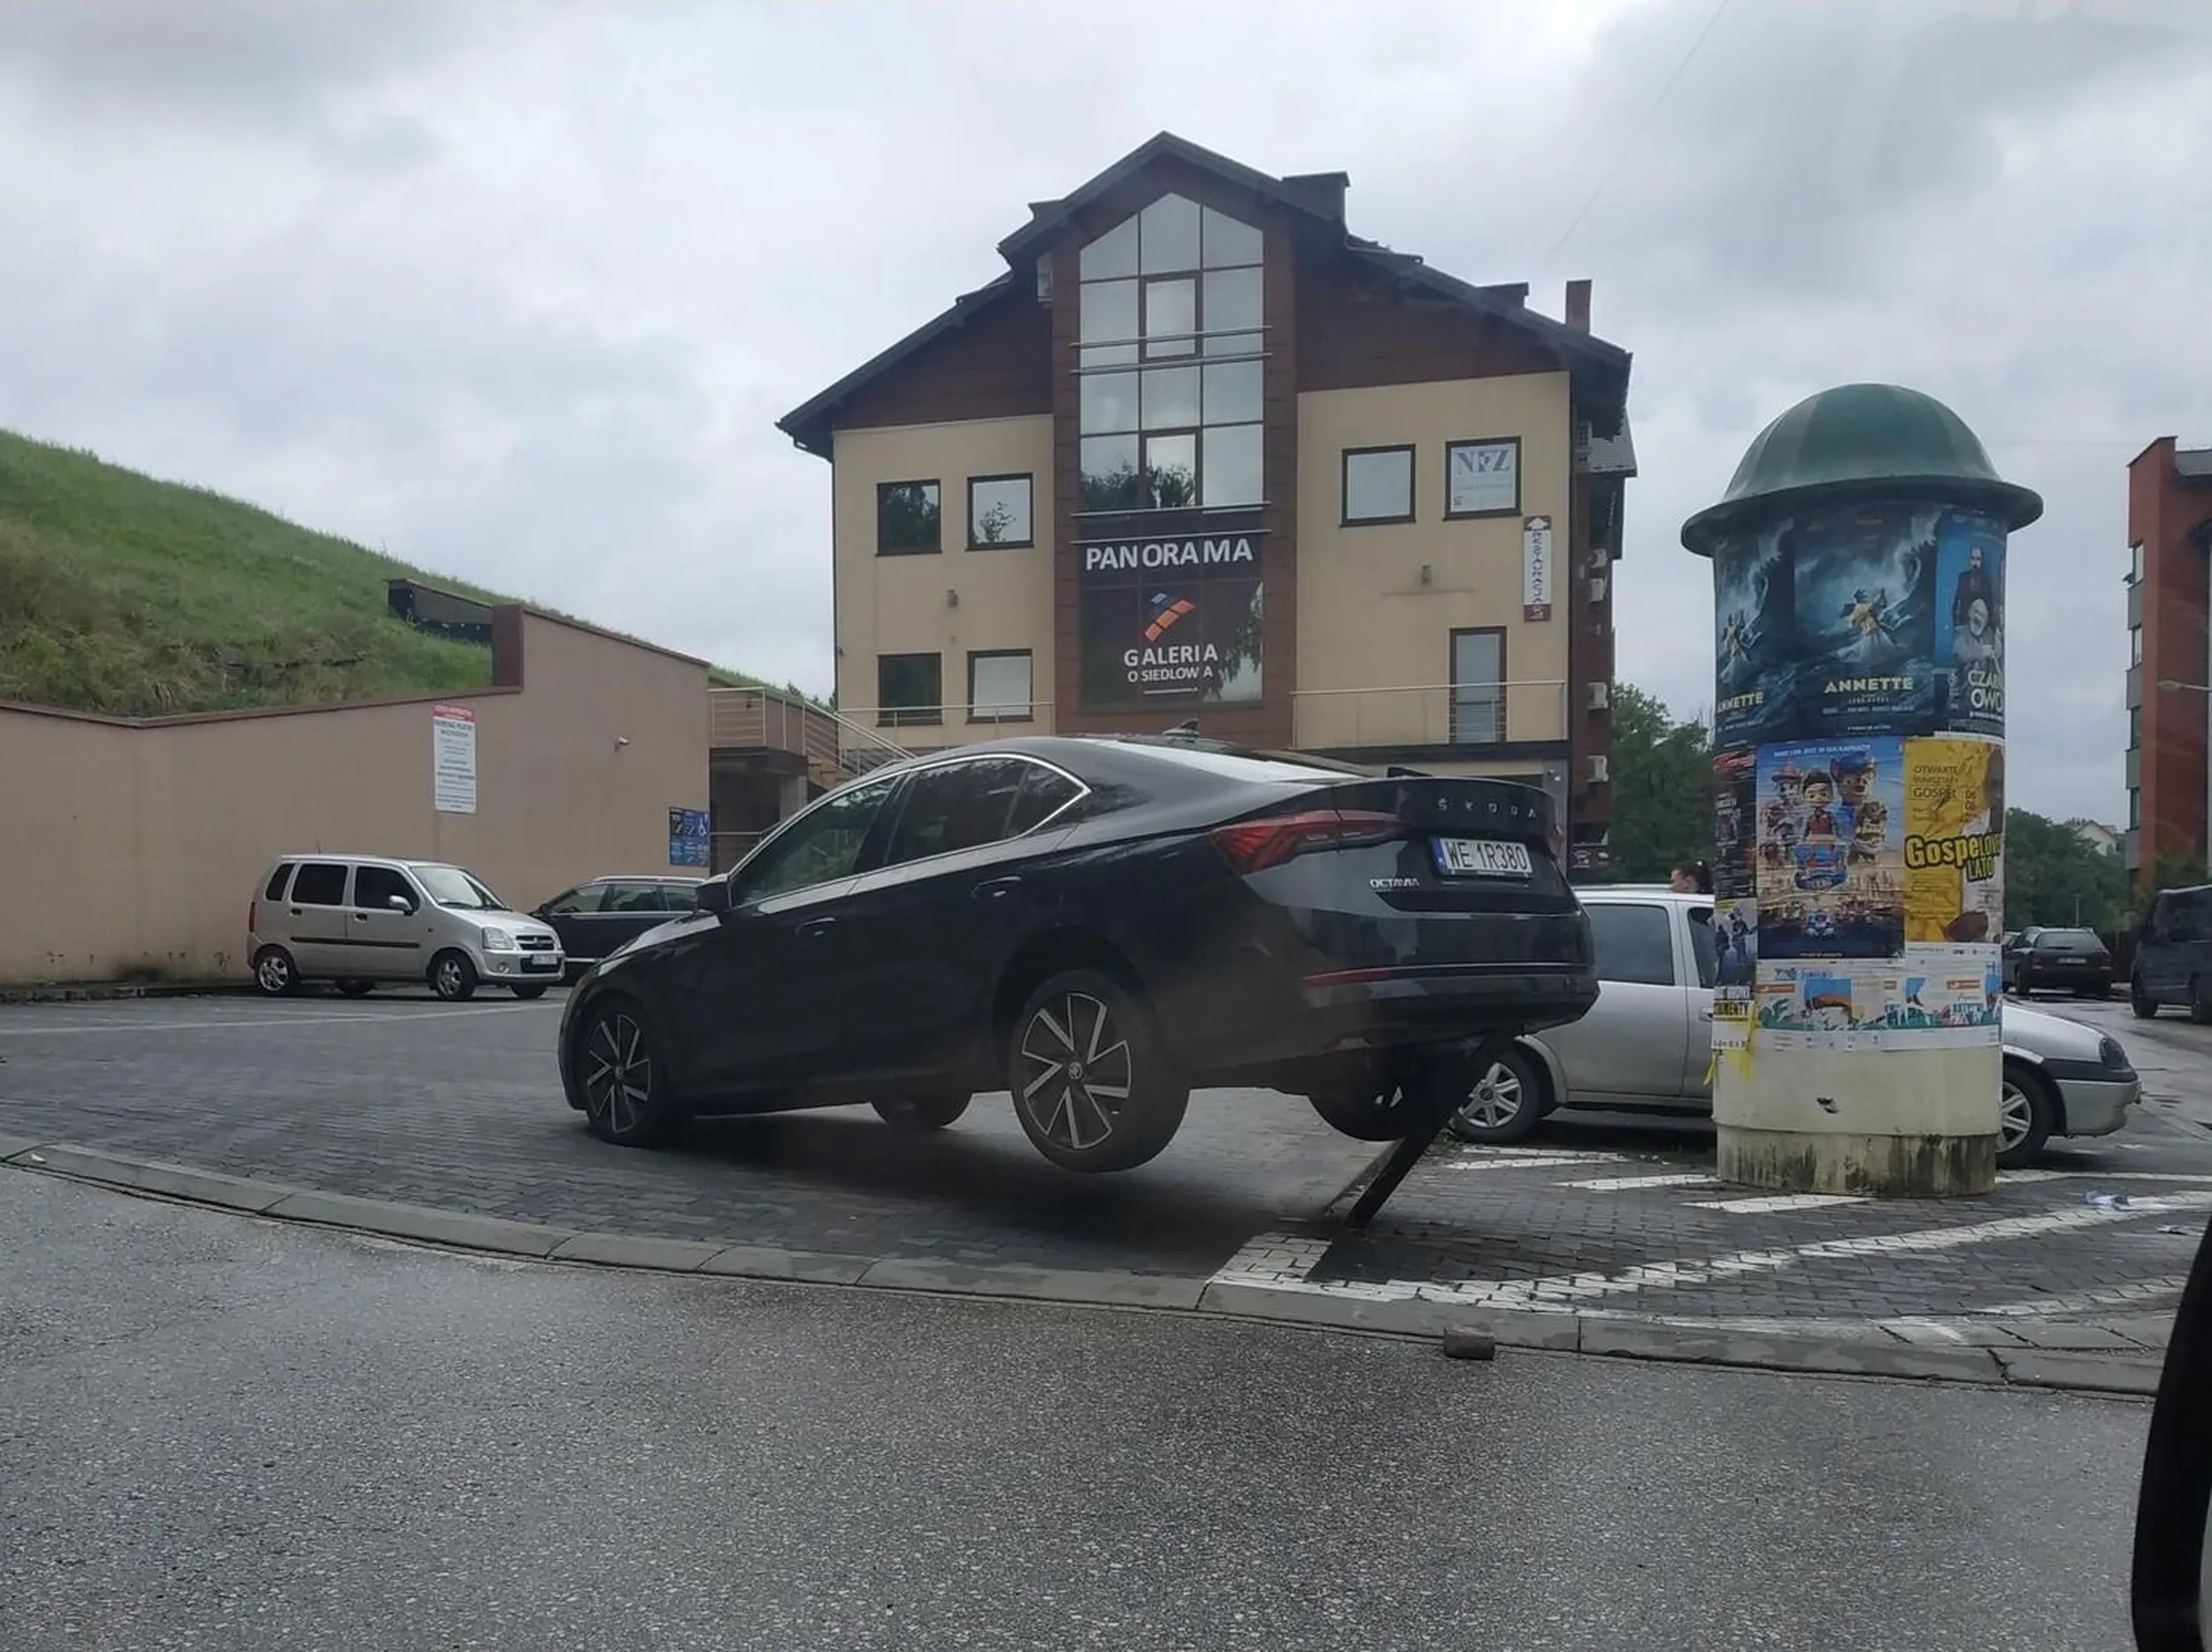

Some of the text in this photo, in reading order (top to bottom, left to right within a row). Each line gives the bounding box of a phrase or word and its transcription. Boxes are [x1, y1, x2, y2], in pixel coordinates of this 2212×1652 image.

[1086, 538, 1254, 571] PANORAMA
[1124, 643, 1219, 668] GALERIA
[1824, 676, 1914, 695] ANNETTE
[1446, 841, 1529, 872] WE 1R380
[1370, 877, 1420, 889] OCTAVIA
